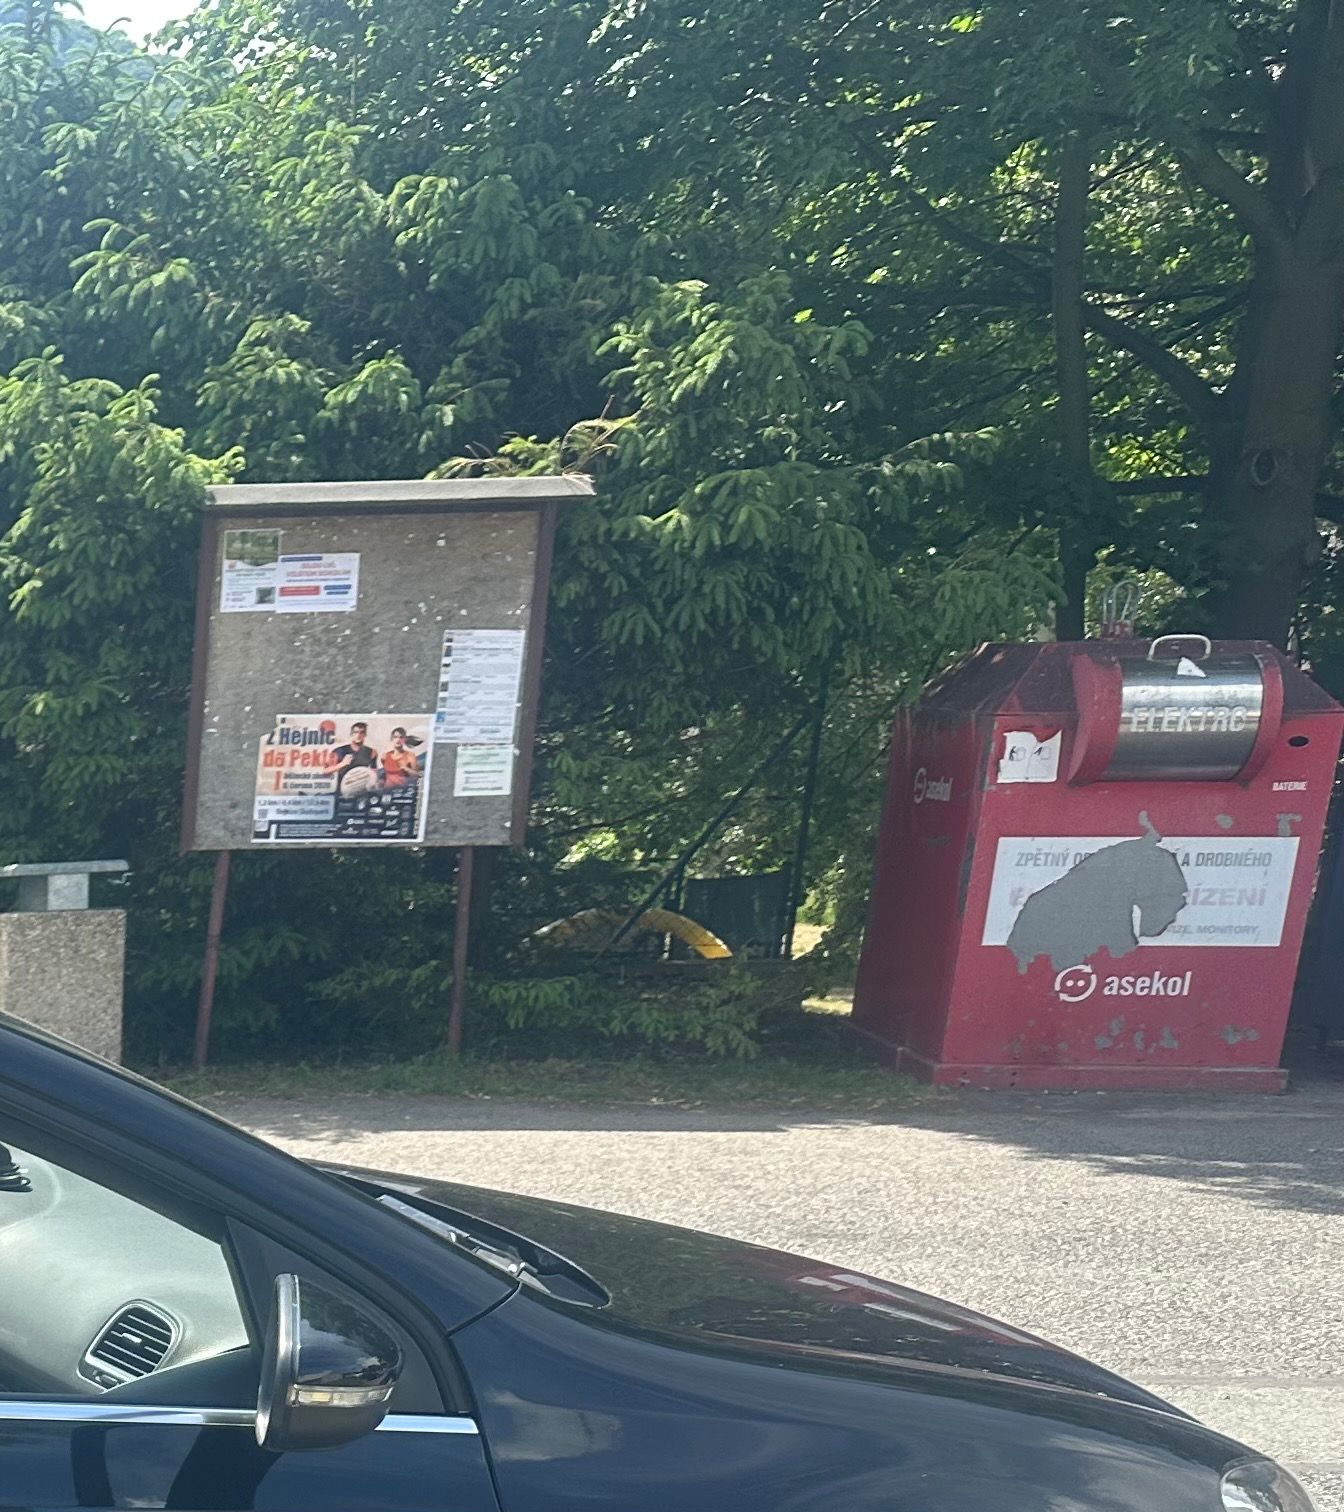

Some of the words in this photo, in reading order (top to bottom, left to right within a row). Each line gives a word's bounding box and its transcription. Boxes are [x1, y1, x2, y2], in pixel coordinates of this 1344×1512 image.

[1130, 706, 1248, 733] ELEKTRO
[278, 726, 337, 747] Hejnic
[289, 749, 338, 769] Pekla
[1015, 848, 1070, 867] ZPĚTNÝ
[1181, 852, 1190, 867] A
[1195, 848, 1273, 867] DROBNÉHO
[1186, 882, 1266, 906] ÍZENÍ
[1103, 970, 1193, 996] asekol
